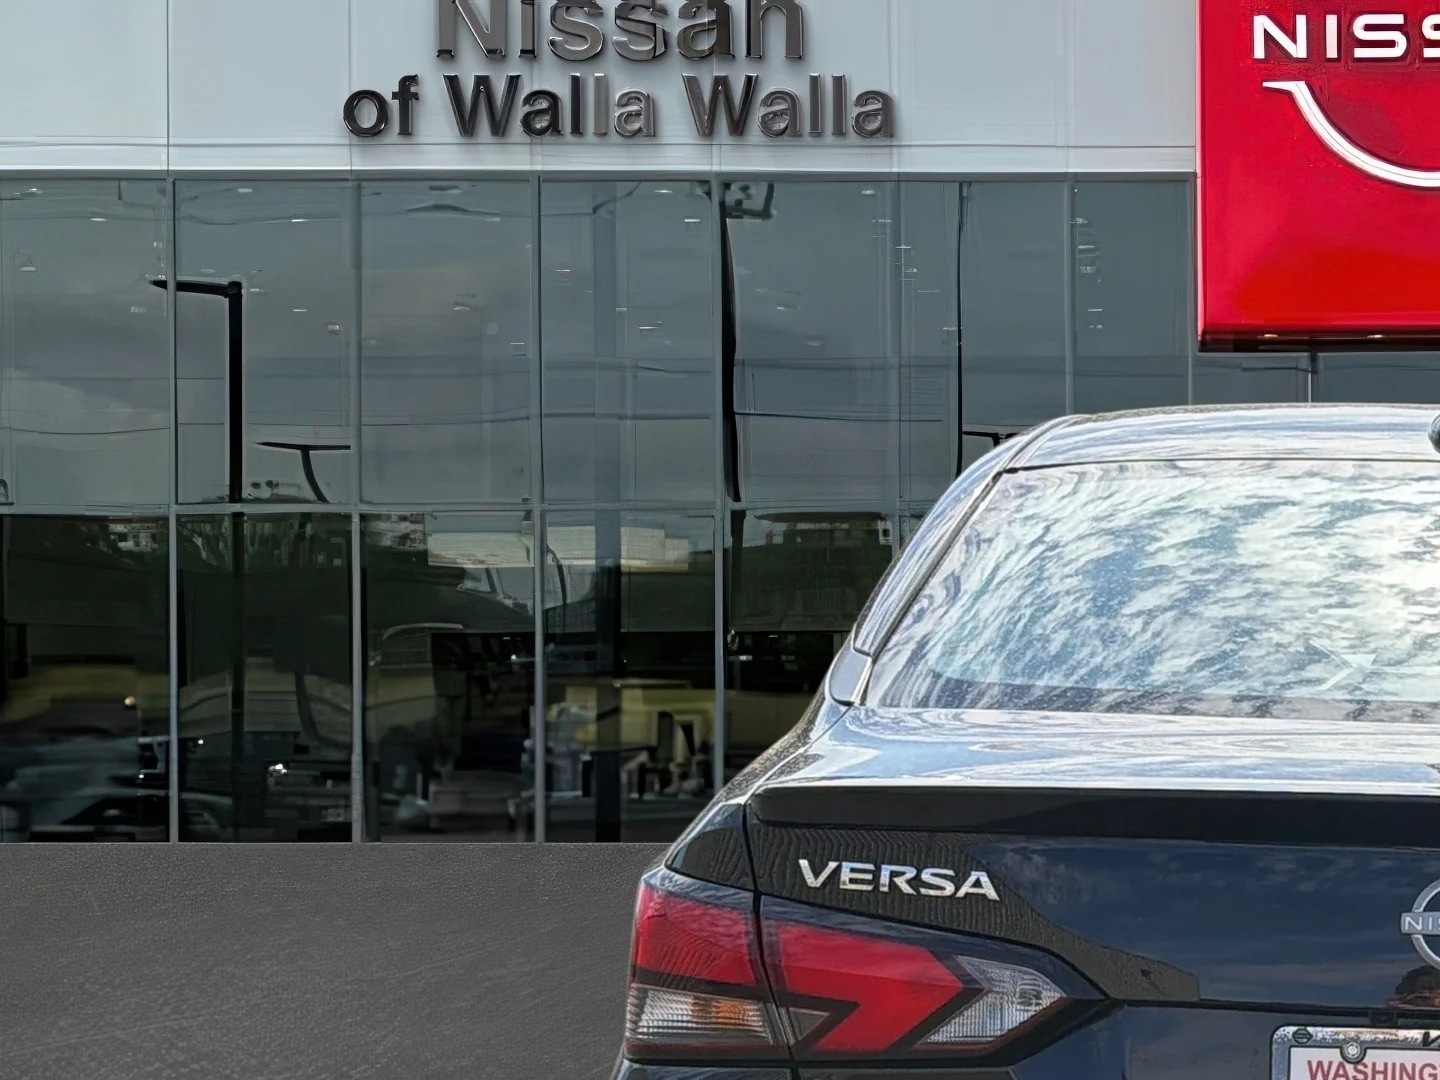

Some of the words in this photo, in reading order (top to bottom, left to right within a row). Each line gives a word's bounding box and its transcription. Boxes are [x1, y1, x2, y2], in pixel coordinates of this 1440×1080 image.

[434, 0, 805, 60] Nissan
[343, 74, 420, 138] of
[442, 73, 657, 138] Walla
[681, 73, 896, 138] Walla
[798, 859, 1001, 901] VERSA
